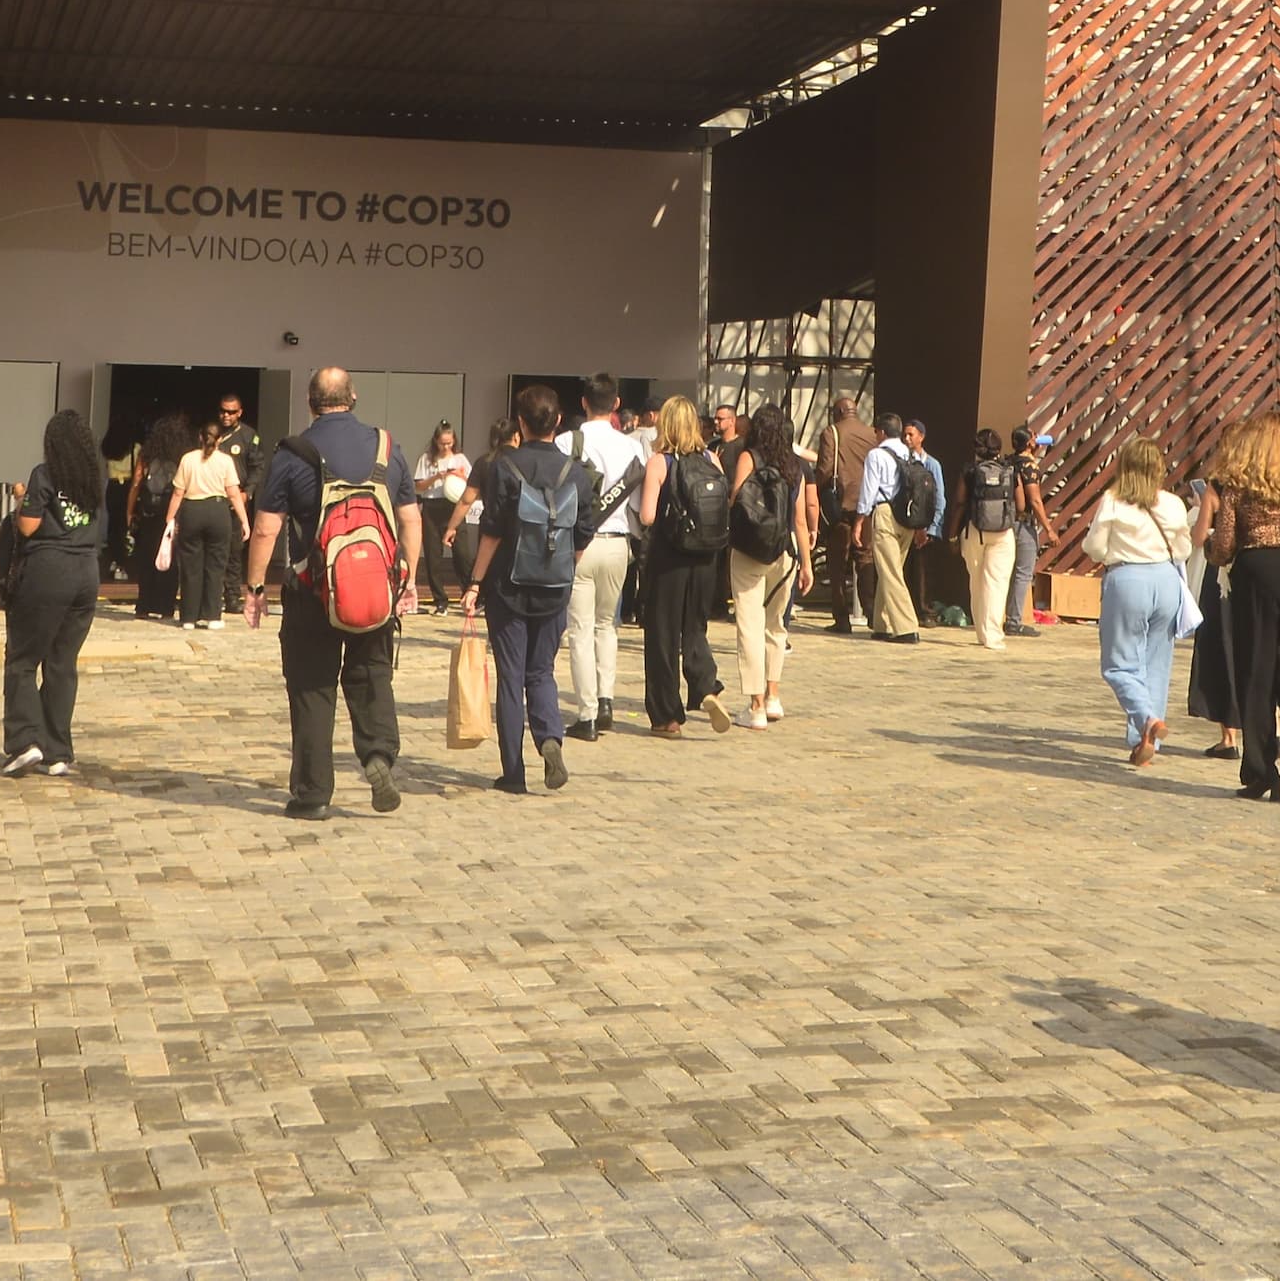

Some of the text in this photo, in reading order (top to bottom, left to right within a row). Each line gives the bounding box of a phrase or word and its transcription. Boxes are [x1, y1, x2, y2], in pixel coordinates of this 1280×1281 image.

[76, 179, 511, 229] WELCOME TO #COP30
[106, 232, 485, 271] BEM-VINDO(A) A #COP30
[599, 479, 626, 512] JOBY
